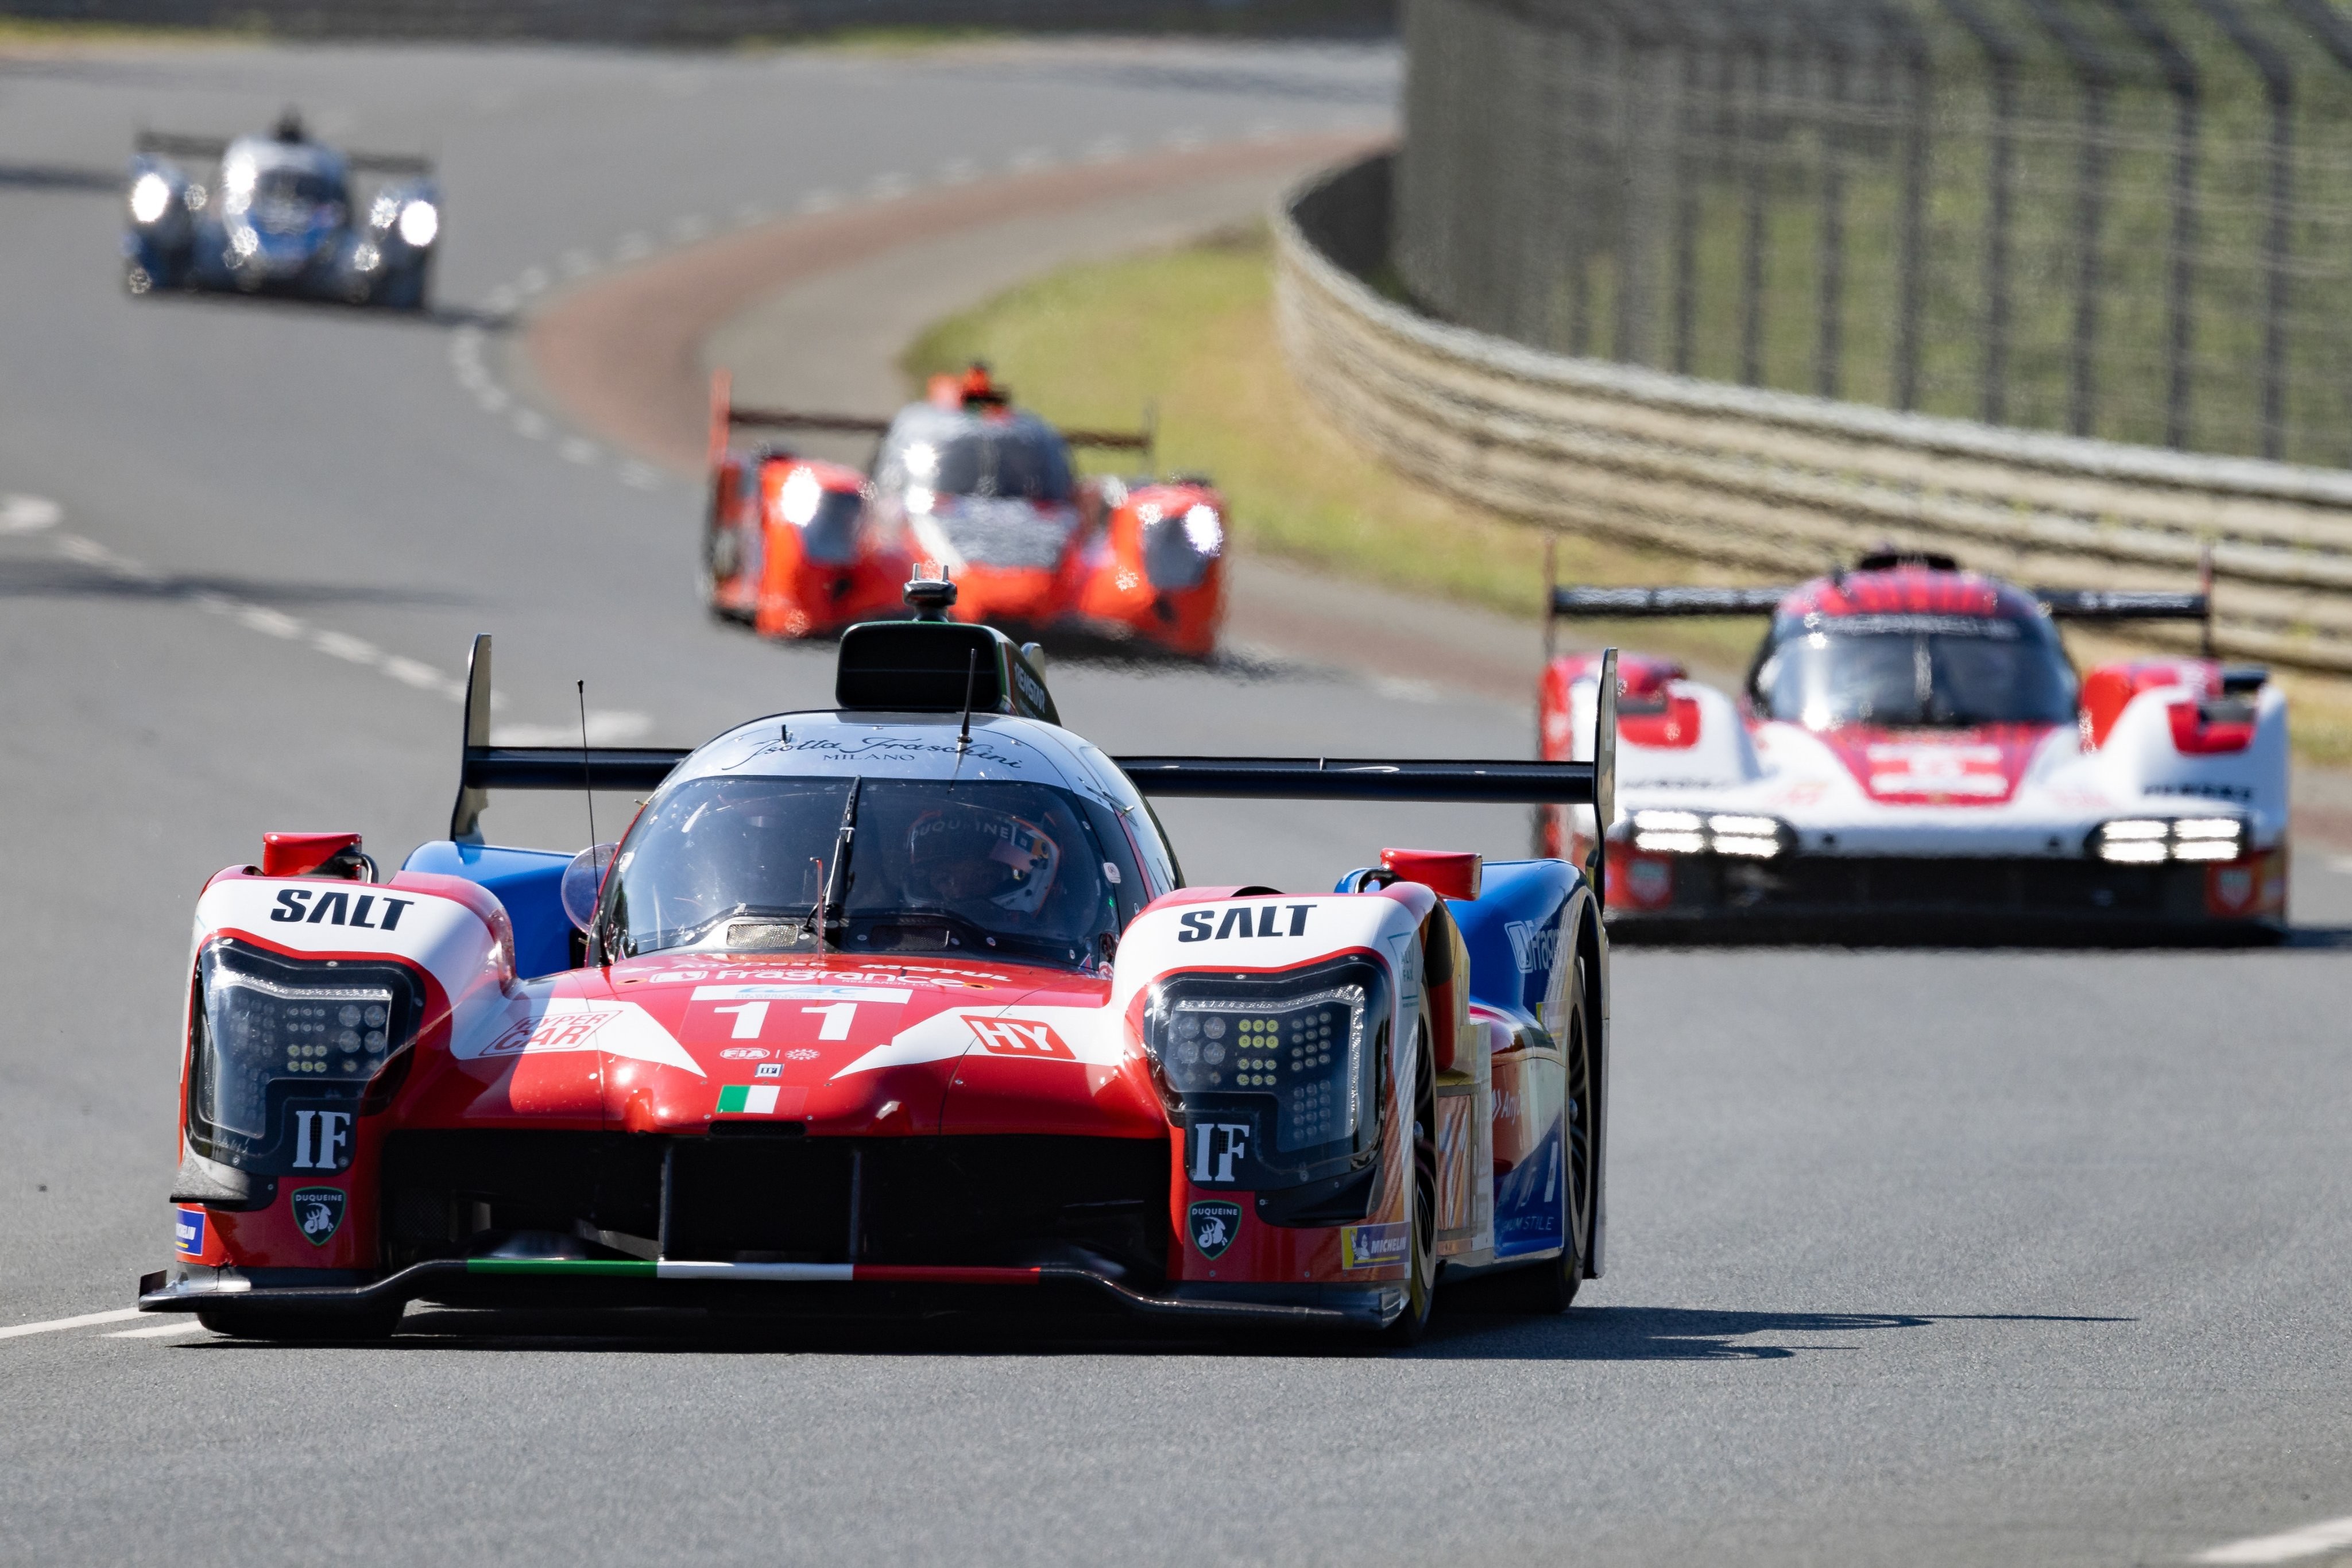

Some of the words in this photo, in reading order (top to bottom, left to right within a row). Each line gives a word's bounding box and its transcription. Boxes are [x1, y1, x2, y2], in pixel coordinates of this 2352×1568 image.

[840, 737, 1022, 769] Fraschini
[270, 889, 415, 931] SALT
[1178, 904, 1317, 943] SALT
[715, 969, 966, 988] Fragrance
[859, 964, 1012, 982] MOTUL
[516, 1014, 609, 1031] HYPER
[714, 1001, 858, 1040] 11
[969, 1020, 1053, 1051] HY
[494, 1025, 591, 1051] CAR
[723, 1050, 764, 1058] FIA
[293, 1110, 351, 1169] IF
[1193, 1124, 1250, 1182] IF
[1371, 1237, 1407, 1254] MICHELIN
